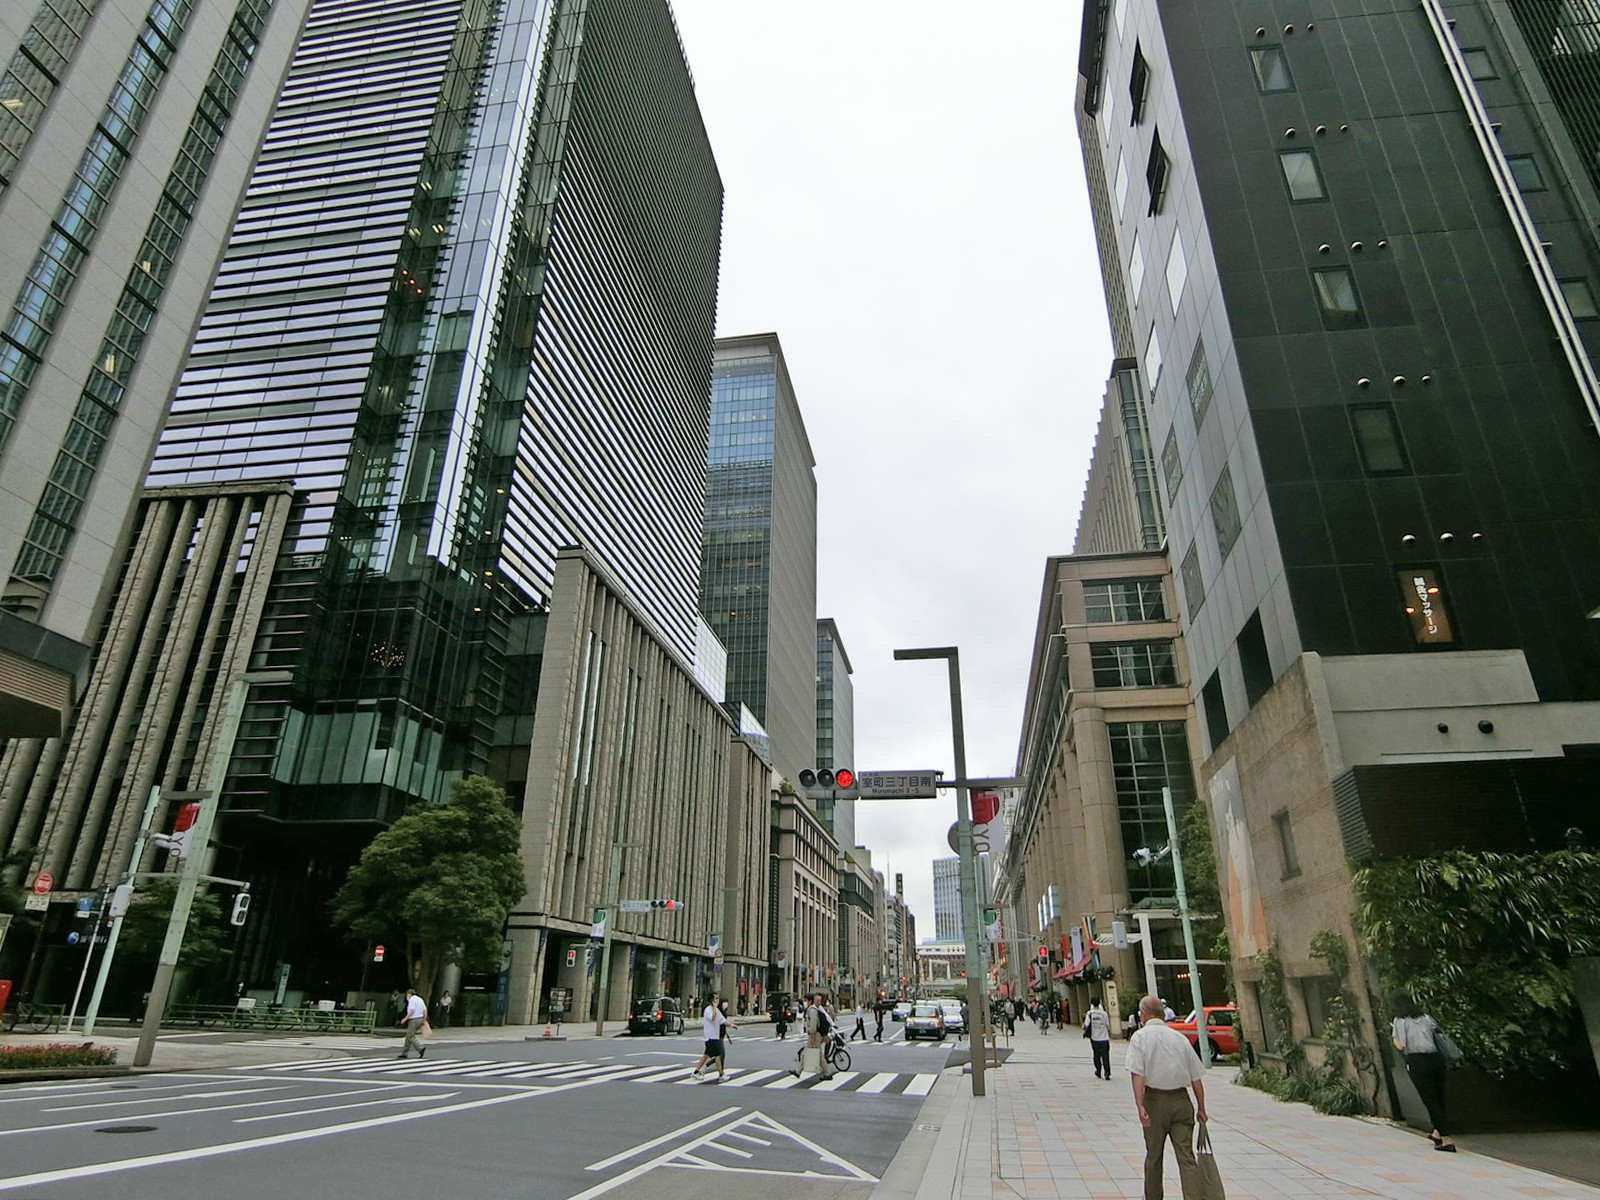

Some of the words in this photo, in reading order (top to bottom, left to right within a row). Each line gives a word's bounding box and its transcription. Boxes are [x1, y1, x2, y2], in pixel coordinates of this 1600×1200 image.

[862, 776, 931, 788] 室町三丁目南
